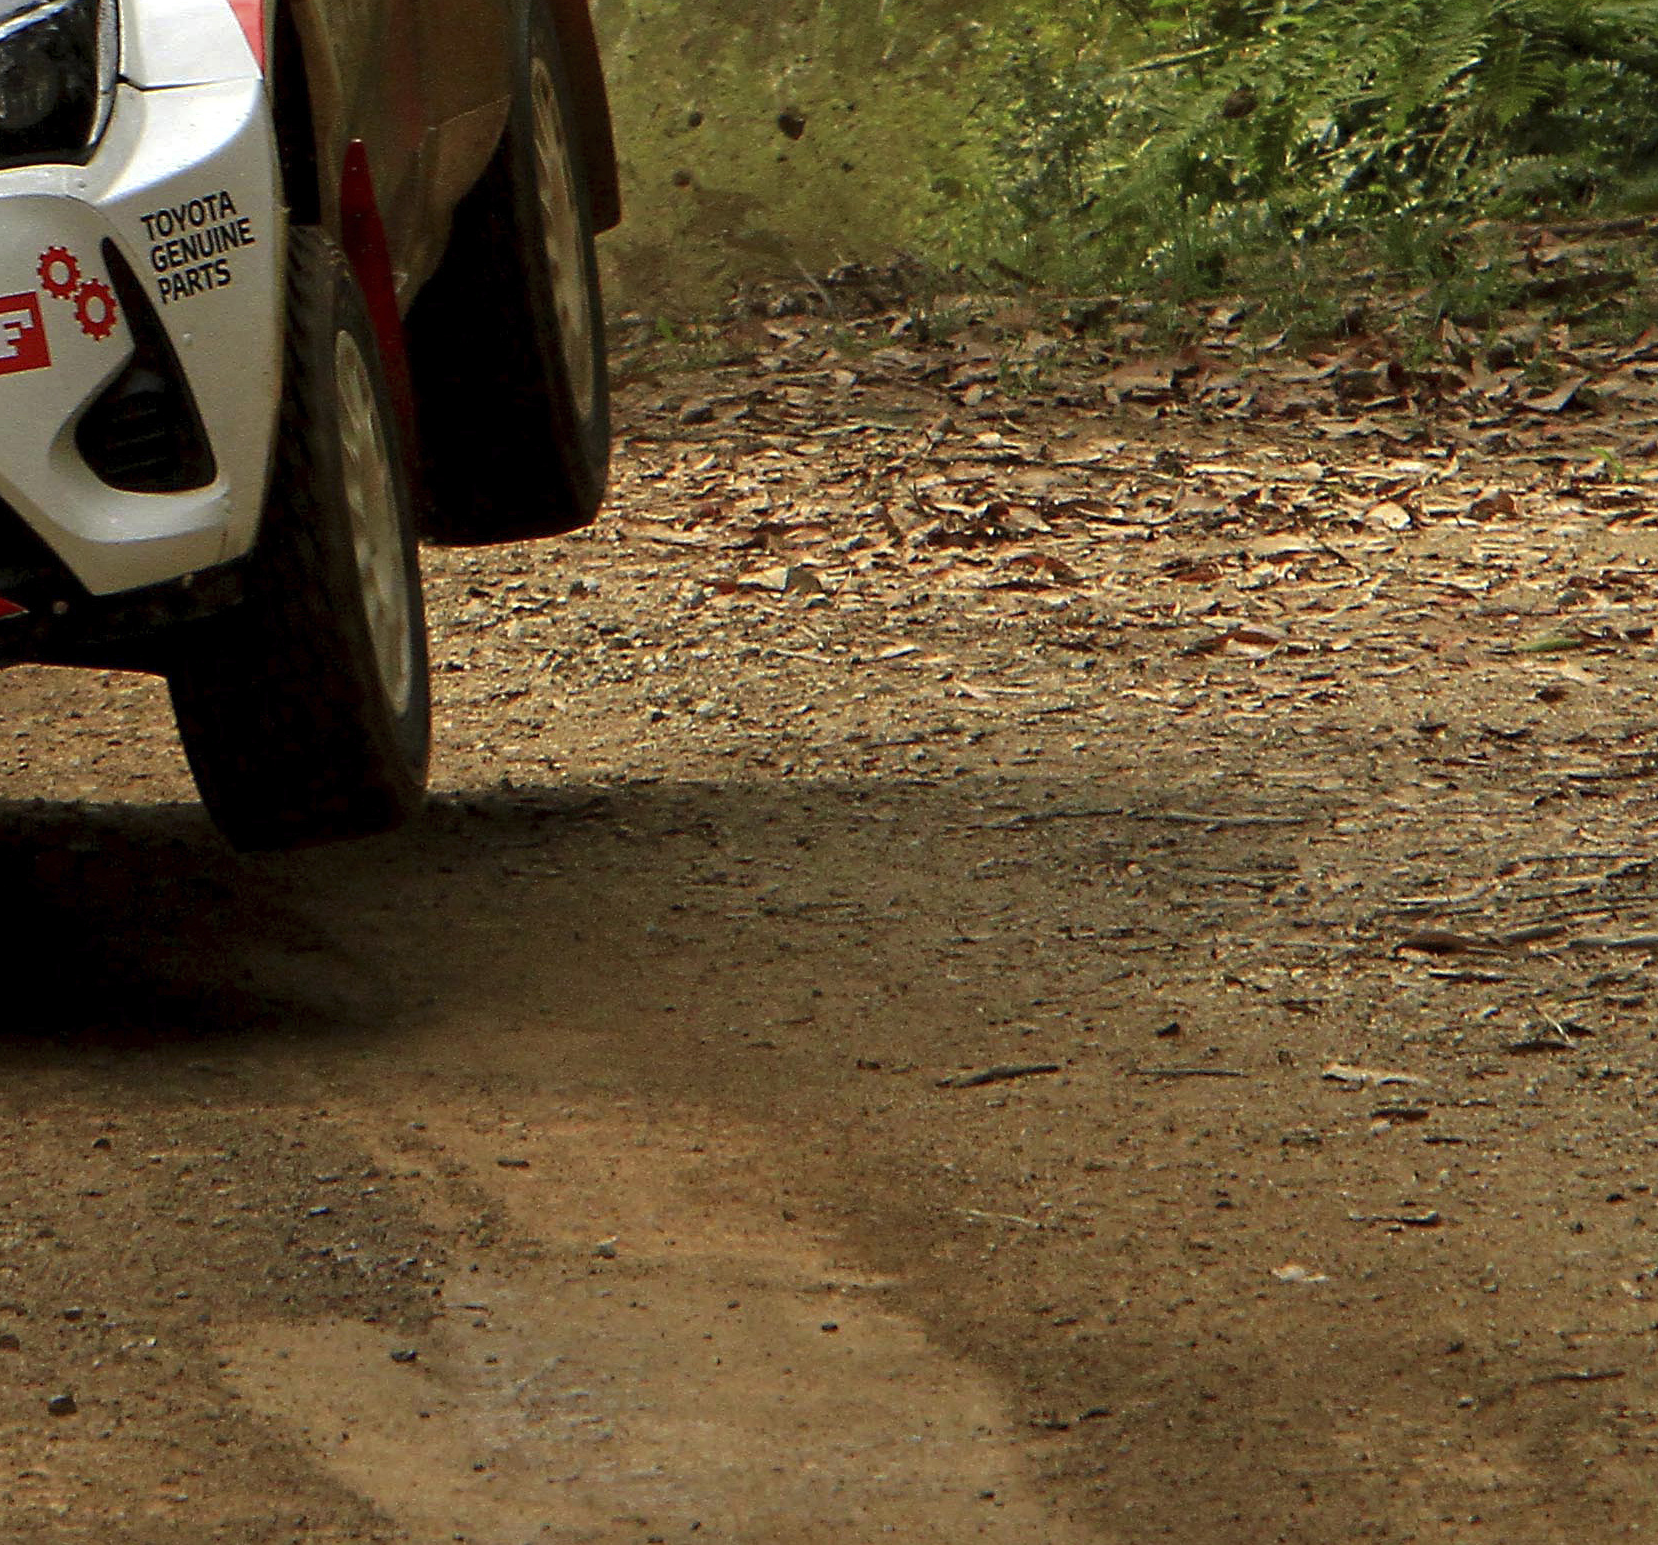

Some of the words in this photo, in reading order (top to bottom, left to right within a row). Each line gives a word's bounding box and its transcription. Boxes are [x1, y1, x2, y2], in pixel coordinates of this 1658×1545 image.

[140, 190, 237, 242] TOYOTA
[150, 217, 256, 273] GENUINE
[157, 259, 232, 306] PARTS
